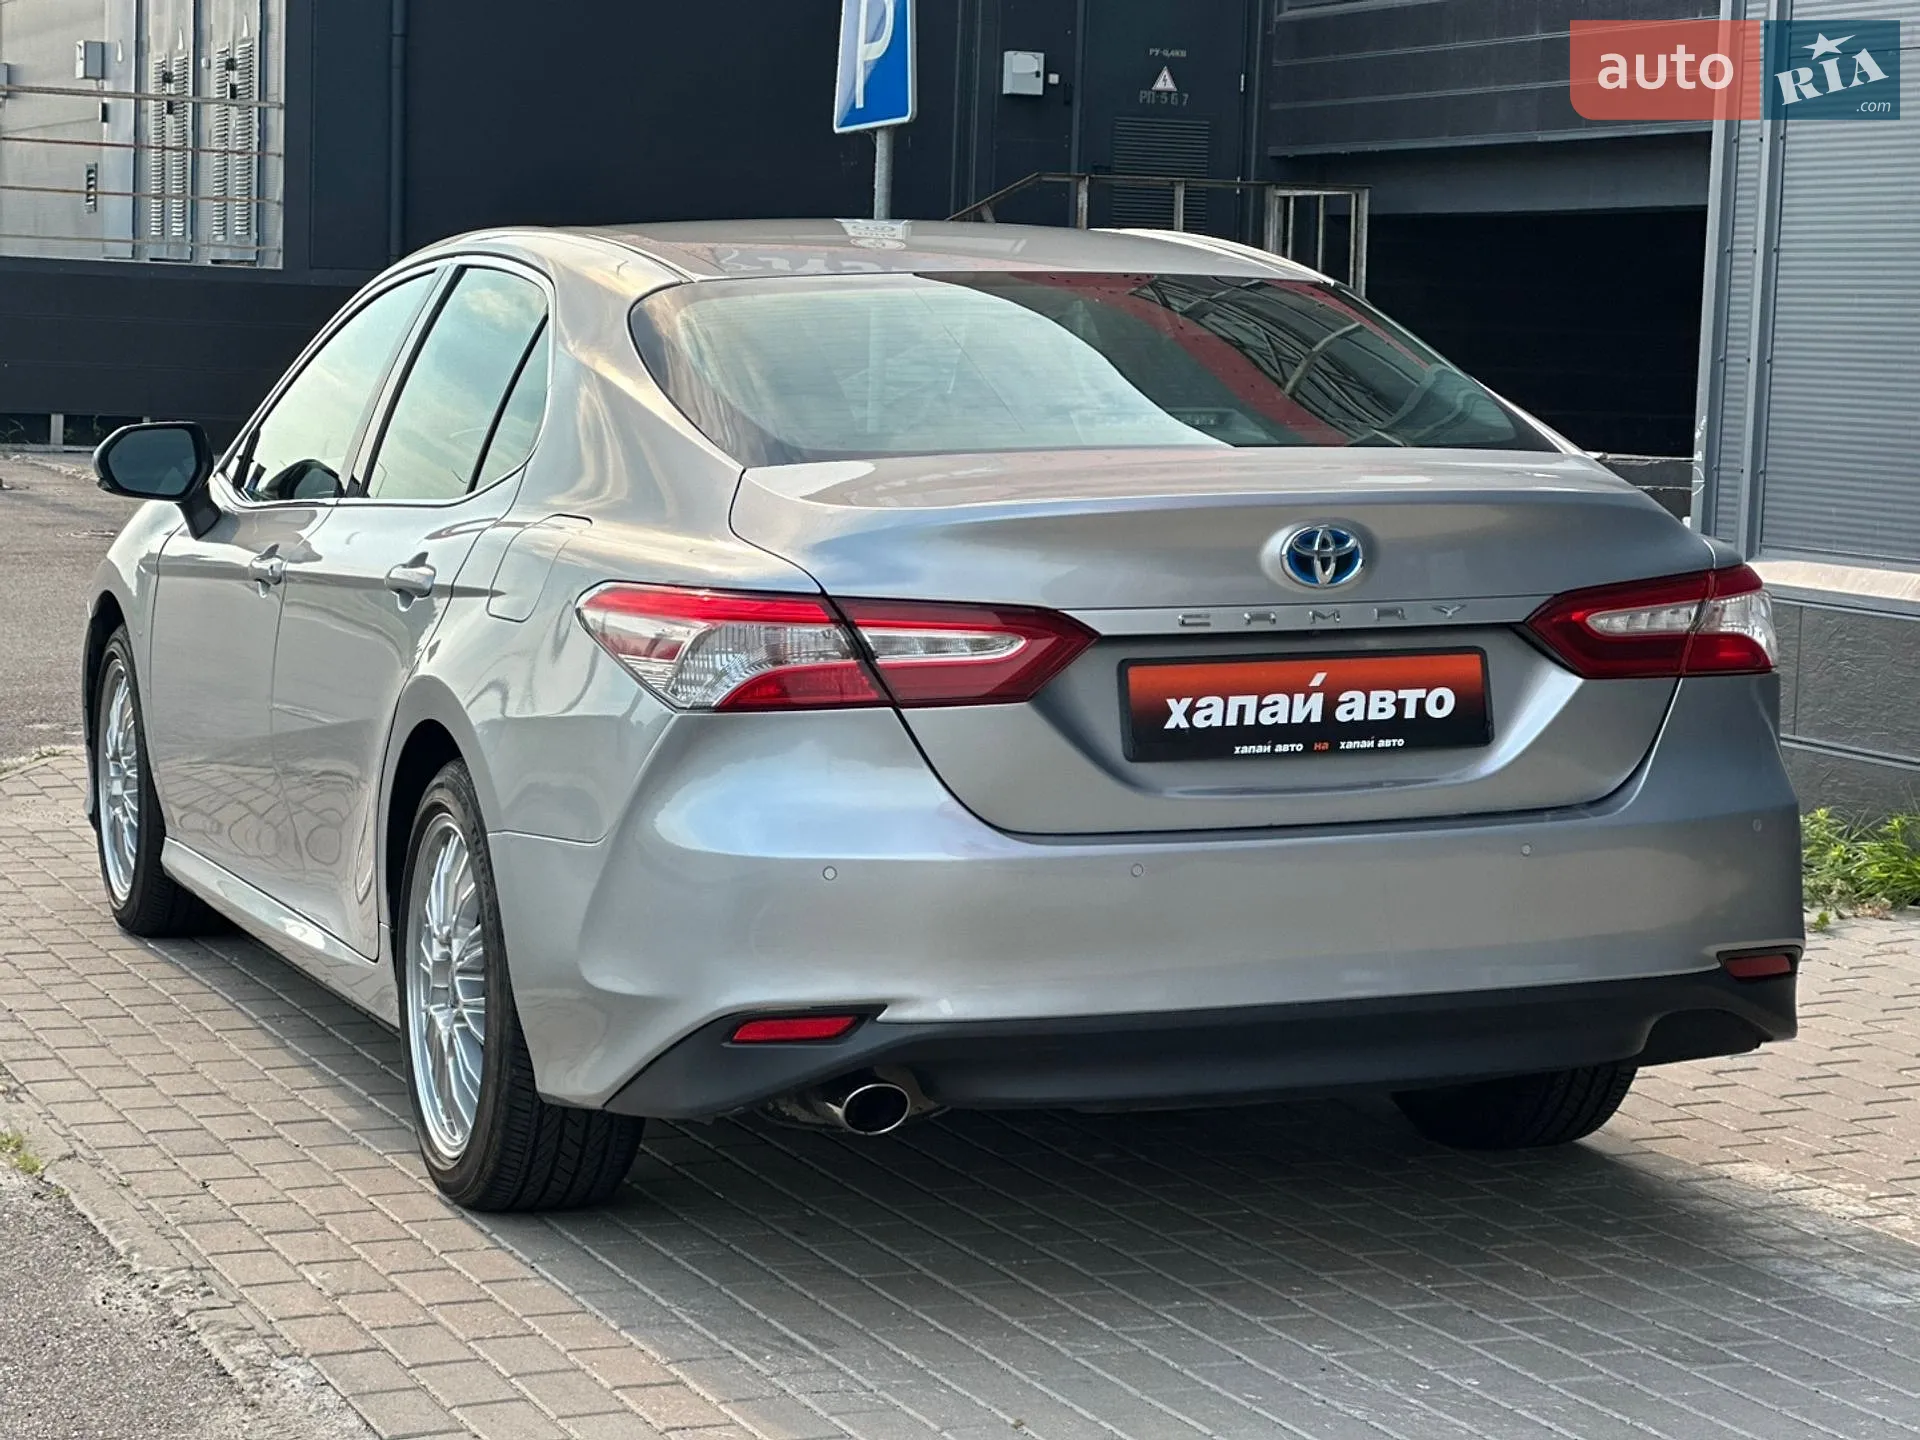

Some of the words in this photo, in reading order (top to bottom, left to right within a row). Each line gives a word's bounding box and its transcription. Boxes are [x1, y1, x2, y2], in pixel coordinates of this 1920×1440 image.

[855, 0, 894, 109] P
[1177, 604, 1467, 627] CAMRY
[1335, 686, 1457, 723] авто
[1274, 741, 1304, 754] авто
[1313, 739, 1330, 751] на
[1377, 737, 1405, 749] авто
